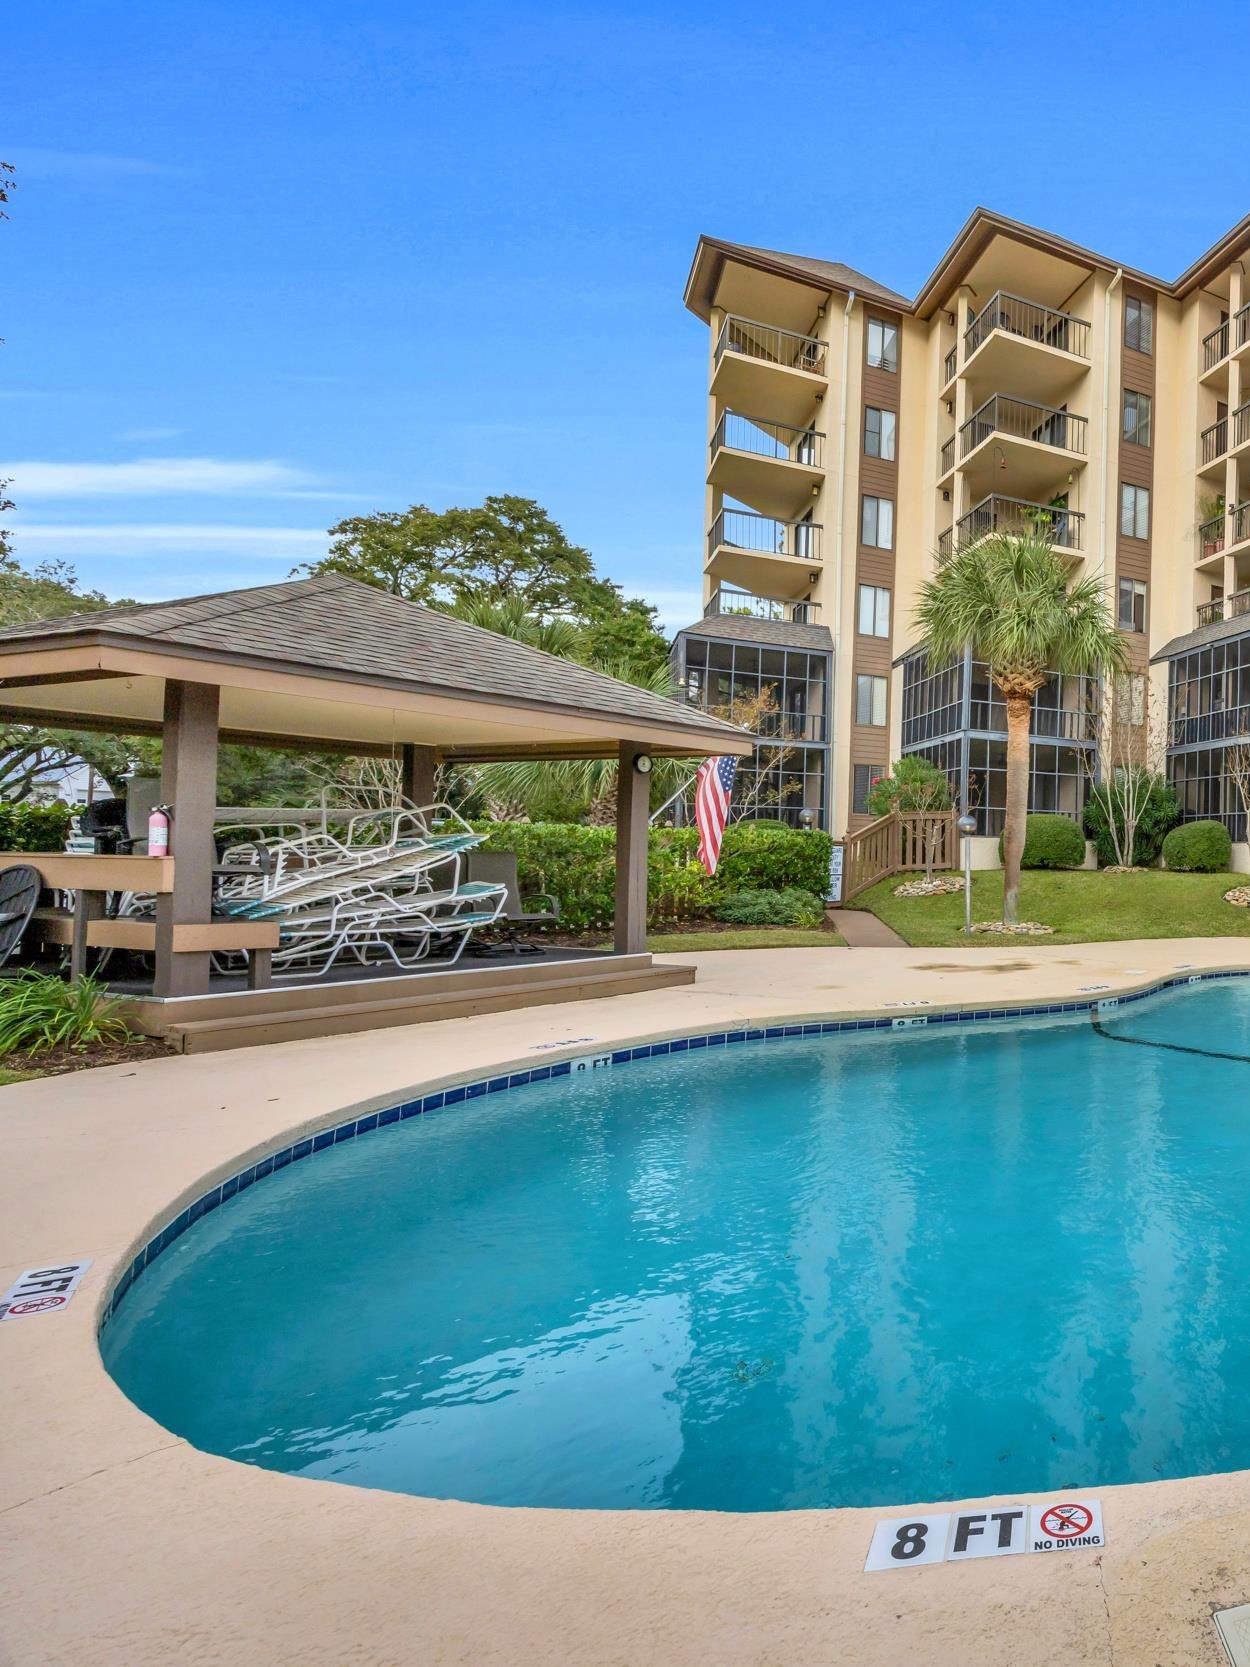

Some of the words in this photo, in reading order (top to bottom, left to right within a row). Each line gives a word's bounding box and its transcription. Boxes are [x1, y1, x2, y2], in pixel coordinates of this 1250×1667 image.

[27, 1265, 80, 1279] 8
[12, 1276, 74, 1299] FT
[891, 1522, 929, 1560] 8
[953, 1511, 1024, 1553] FT
[1034, 1540, 1053, 1551] NO
[1056, 1535, 1101, 1549] DIVING
